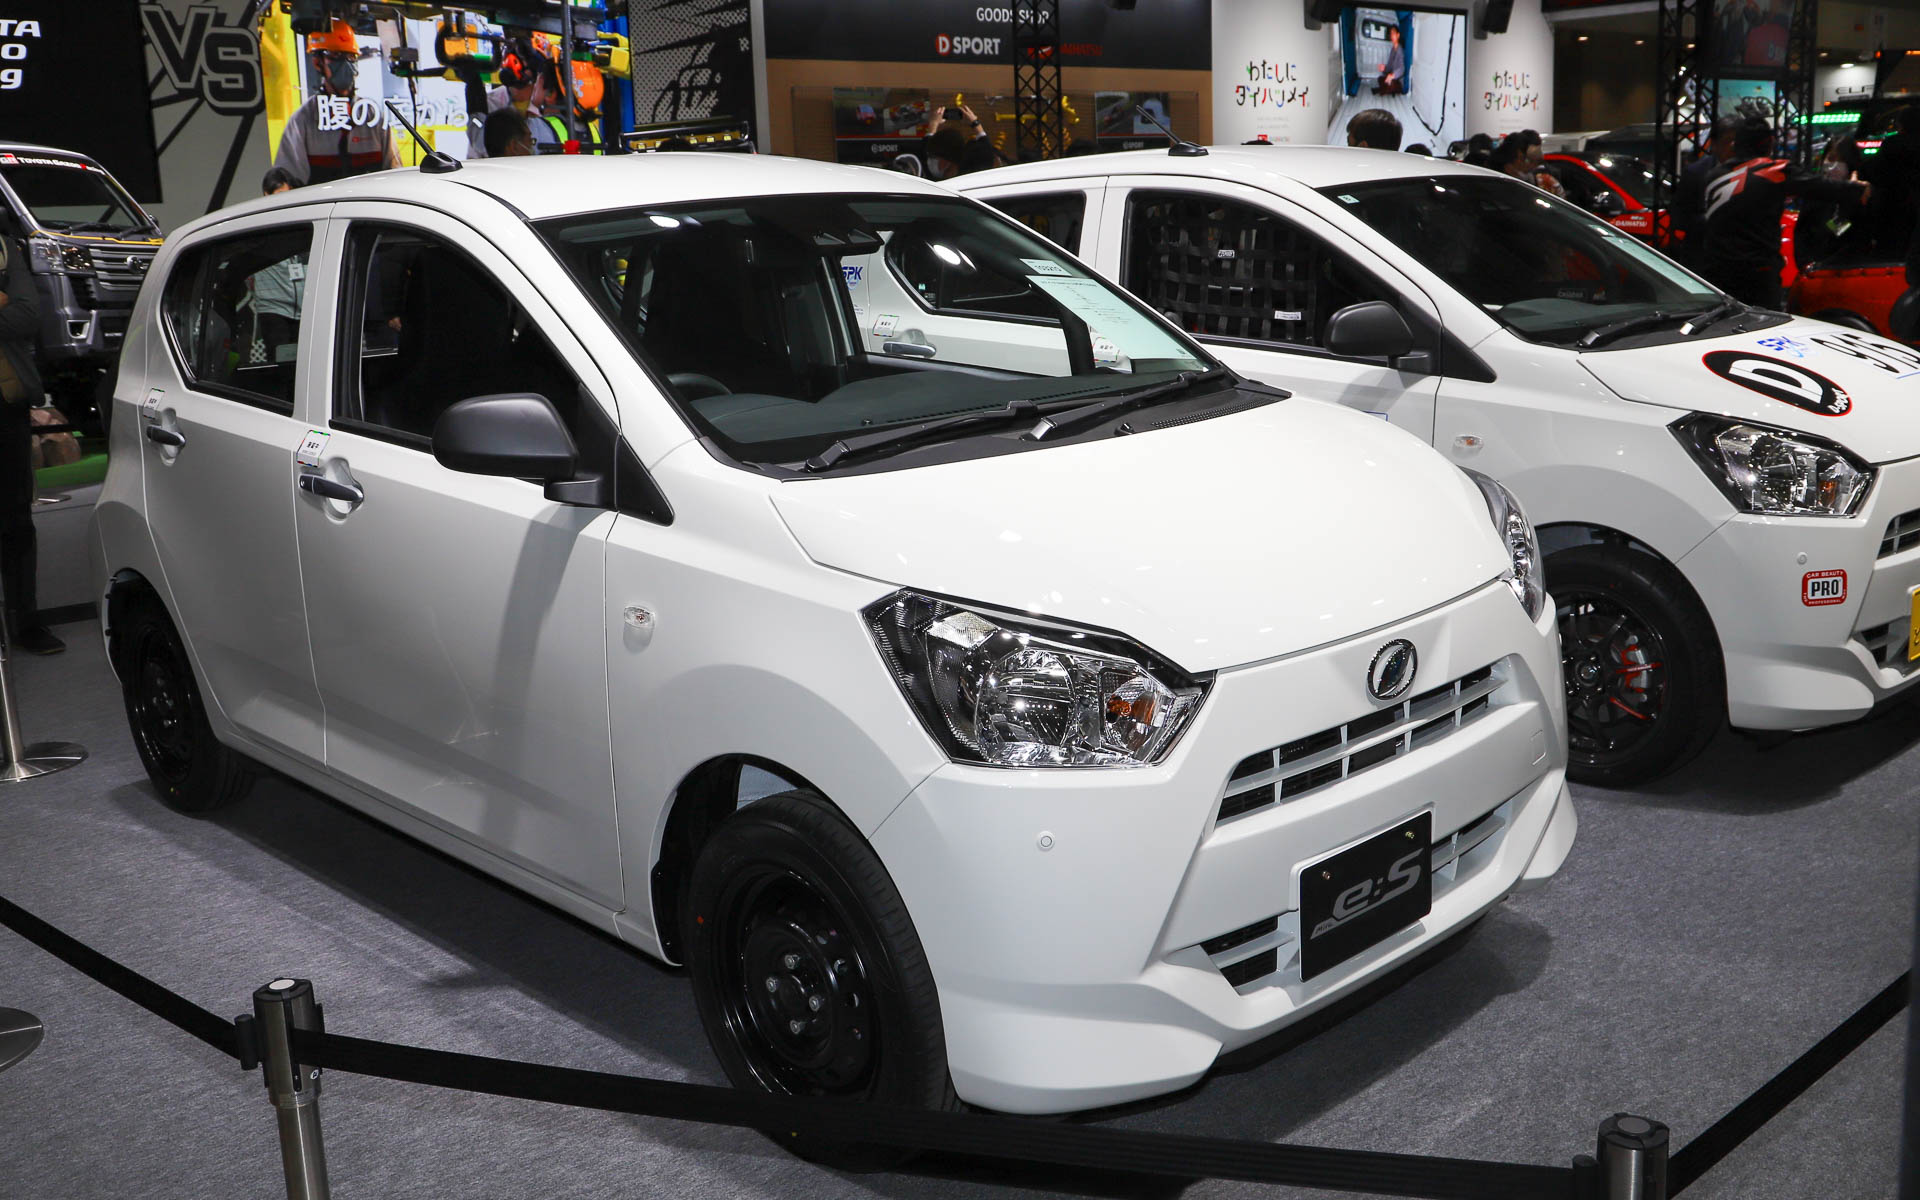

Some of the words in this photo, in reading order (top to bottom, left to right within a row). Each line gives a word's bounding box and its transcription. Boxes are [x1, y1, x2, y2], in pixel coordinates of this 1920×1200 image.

[953, 37, 1001, 55] SPORT
[841, 265, 864, 281] SPK
[1811, 579, 1840, 597] PRO
